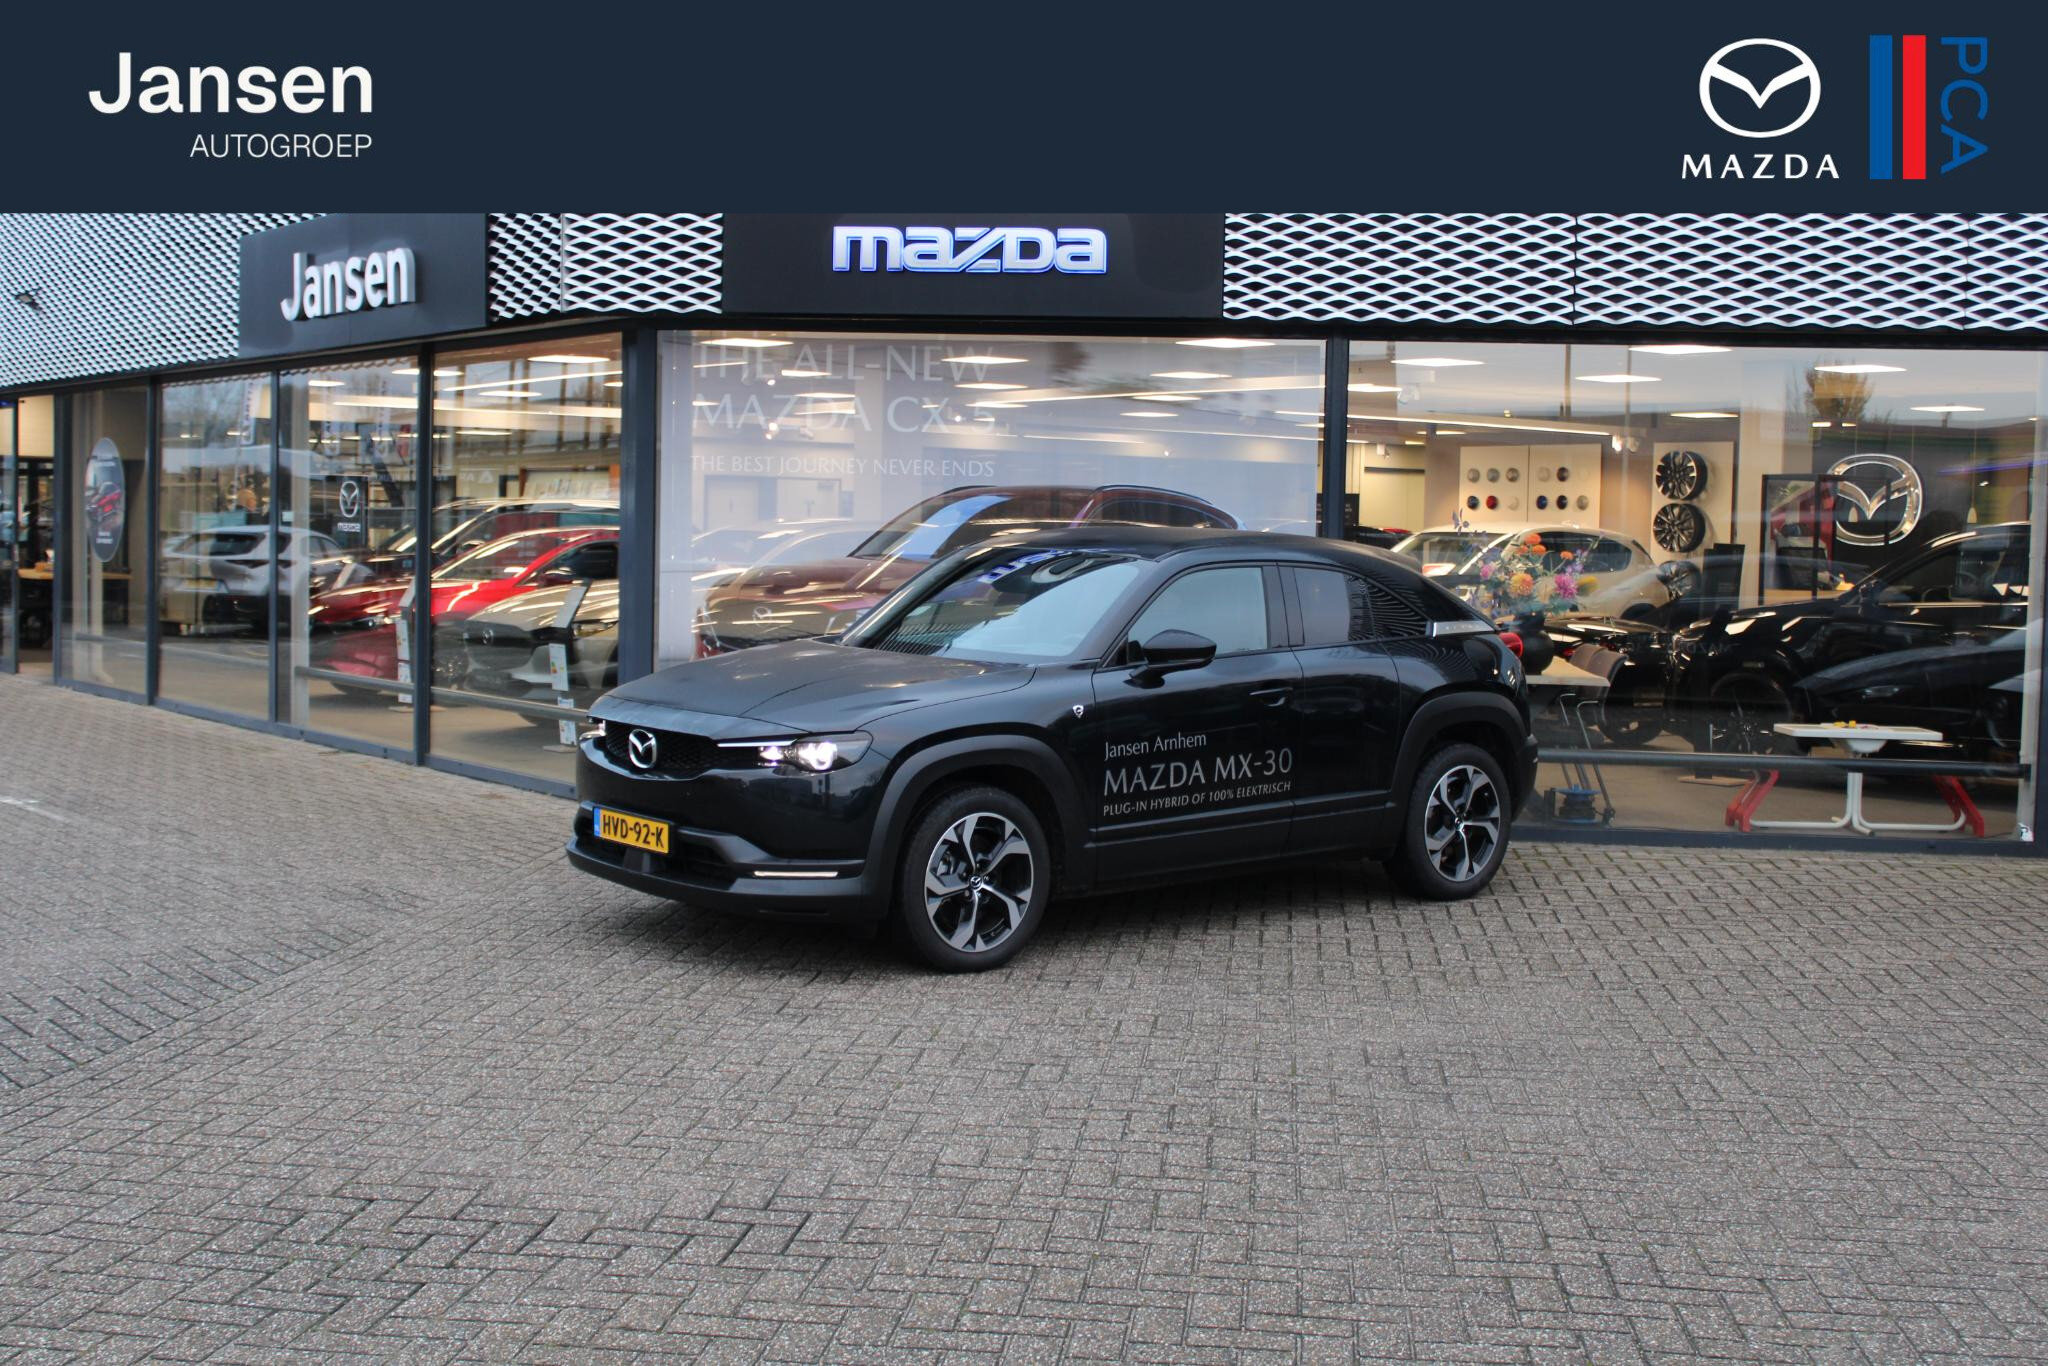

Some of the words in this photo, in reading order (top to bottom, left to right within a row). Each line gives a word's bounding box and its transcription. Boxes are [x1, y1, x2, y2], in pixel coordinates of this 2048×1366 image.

[280, 247, 416, 321] Jansen
[793, 344, 994, 382] ALL-NEW
[692, 392, 872, 432] MAZDA
[690, 455, 725, 472] THE
[732, 455, 775, 473] BEST
[778, 456, 868, 477] JOURNEY
[873, 458, 933, 477] NEVER
[942, 460, 995, 478] ENDS
[1104, 741, 1149, 762] Jansen
[1153, 731, 1207, 753] Arnhem
[1103, 760, 1206, 796] MAZDA
[1214, 748, 1293, 782] MX-30
[1103, 801, 1148, 817] PLUG-IN
[1150, 793, 1189, 810] HYBRID
[1191, 793, 1206, 805] OF
[1209, 789, 1234, 802] 100%
[1236, 781, 1291, 799] ELEKTRISCH
[602, 814, 665, 849] HVD-92-K
